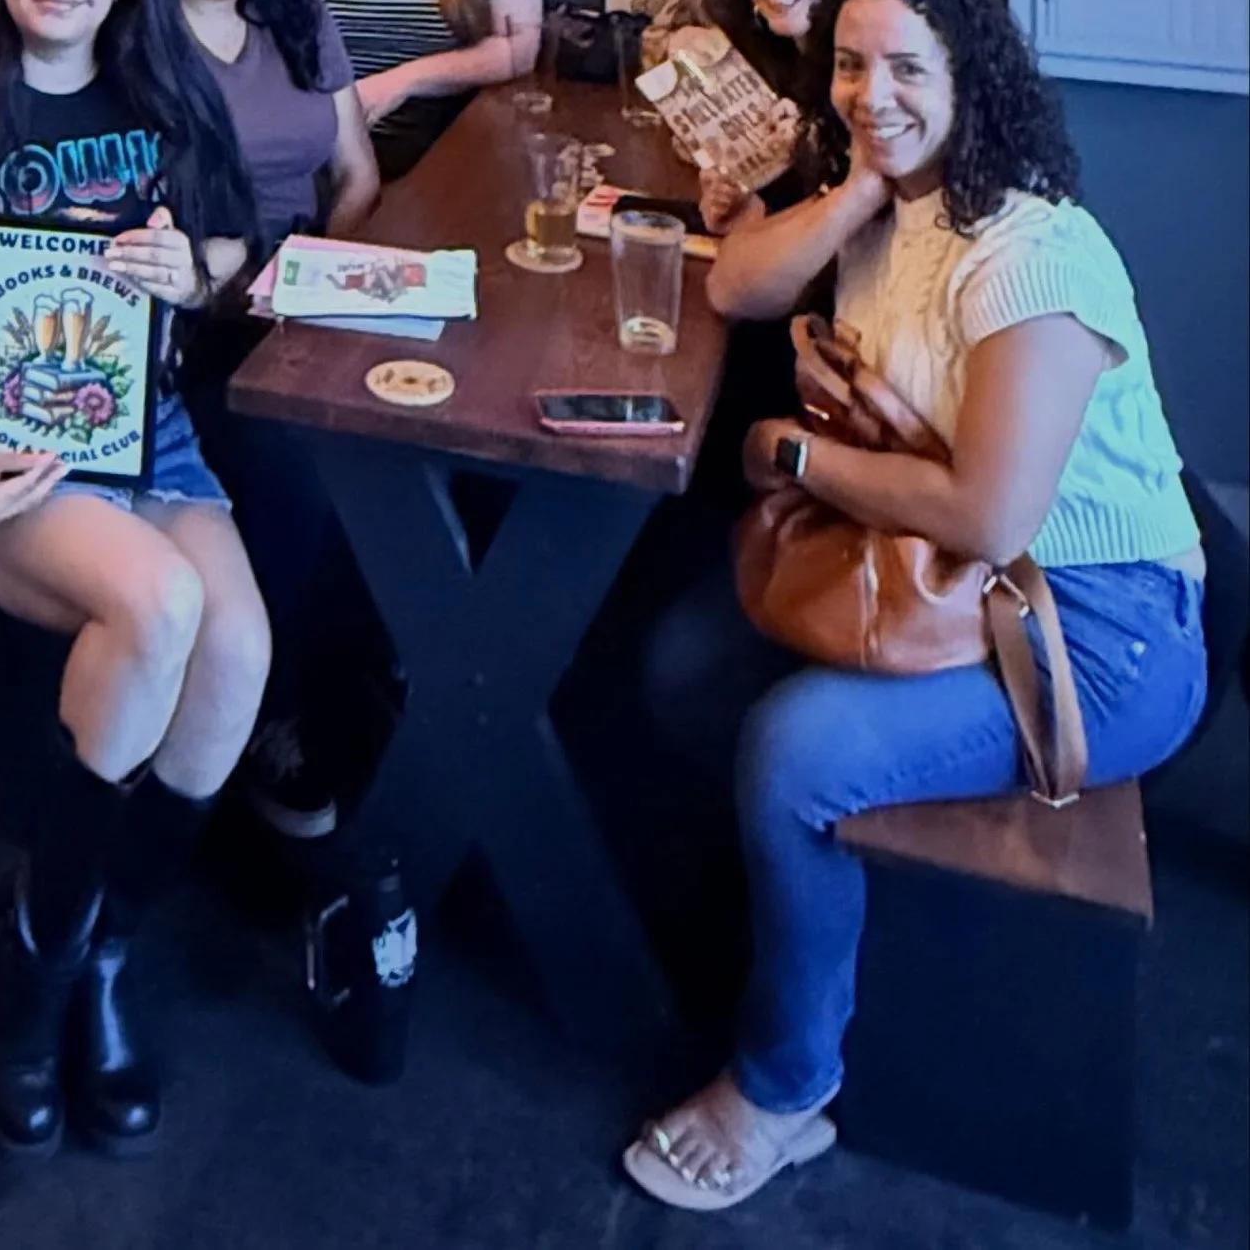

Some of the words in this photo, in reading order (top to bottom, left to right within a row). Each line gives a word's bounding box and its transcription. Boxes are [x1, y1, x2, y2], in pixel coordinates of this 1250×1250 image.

[59, 265, 72, 278] &
[77, 266, 141, 307] BREWS
[101, 430, 142, 456] CLUB
